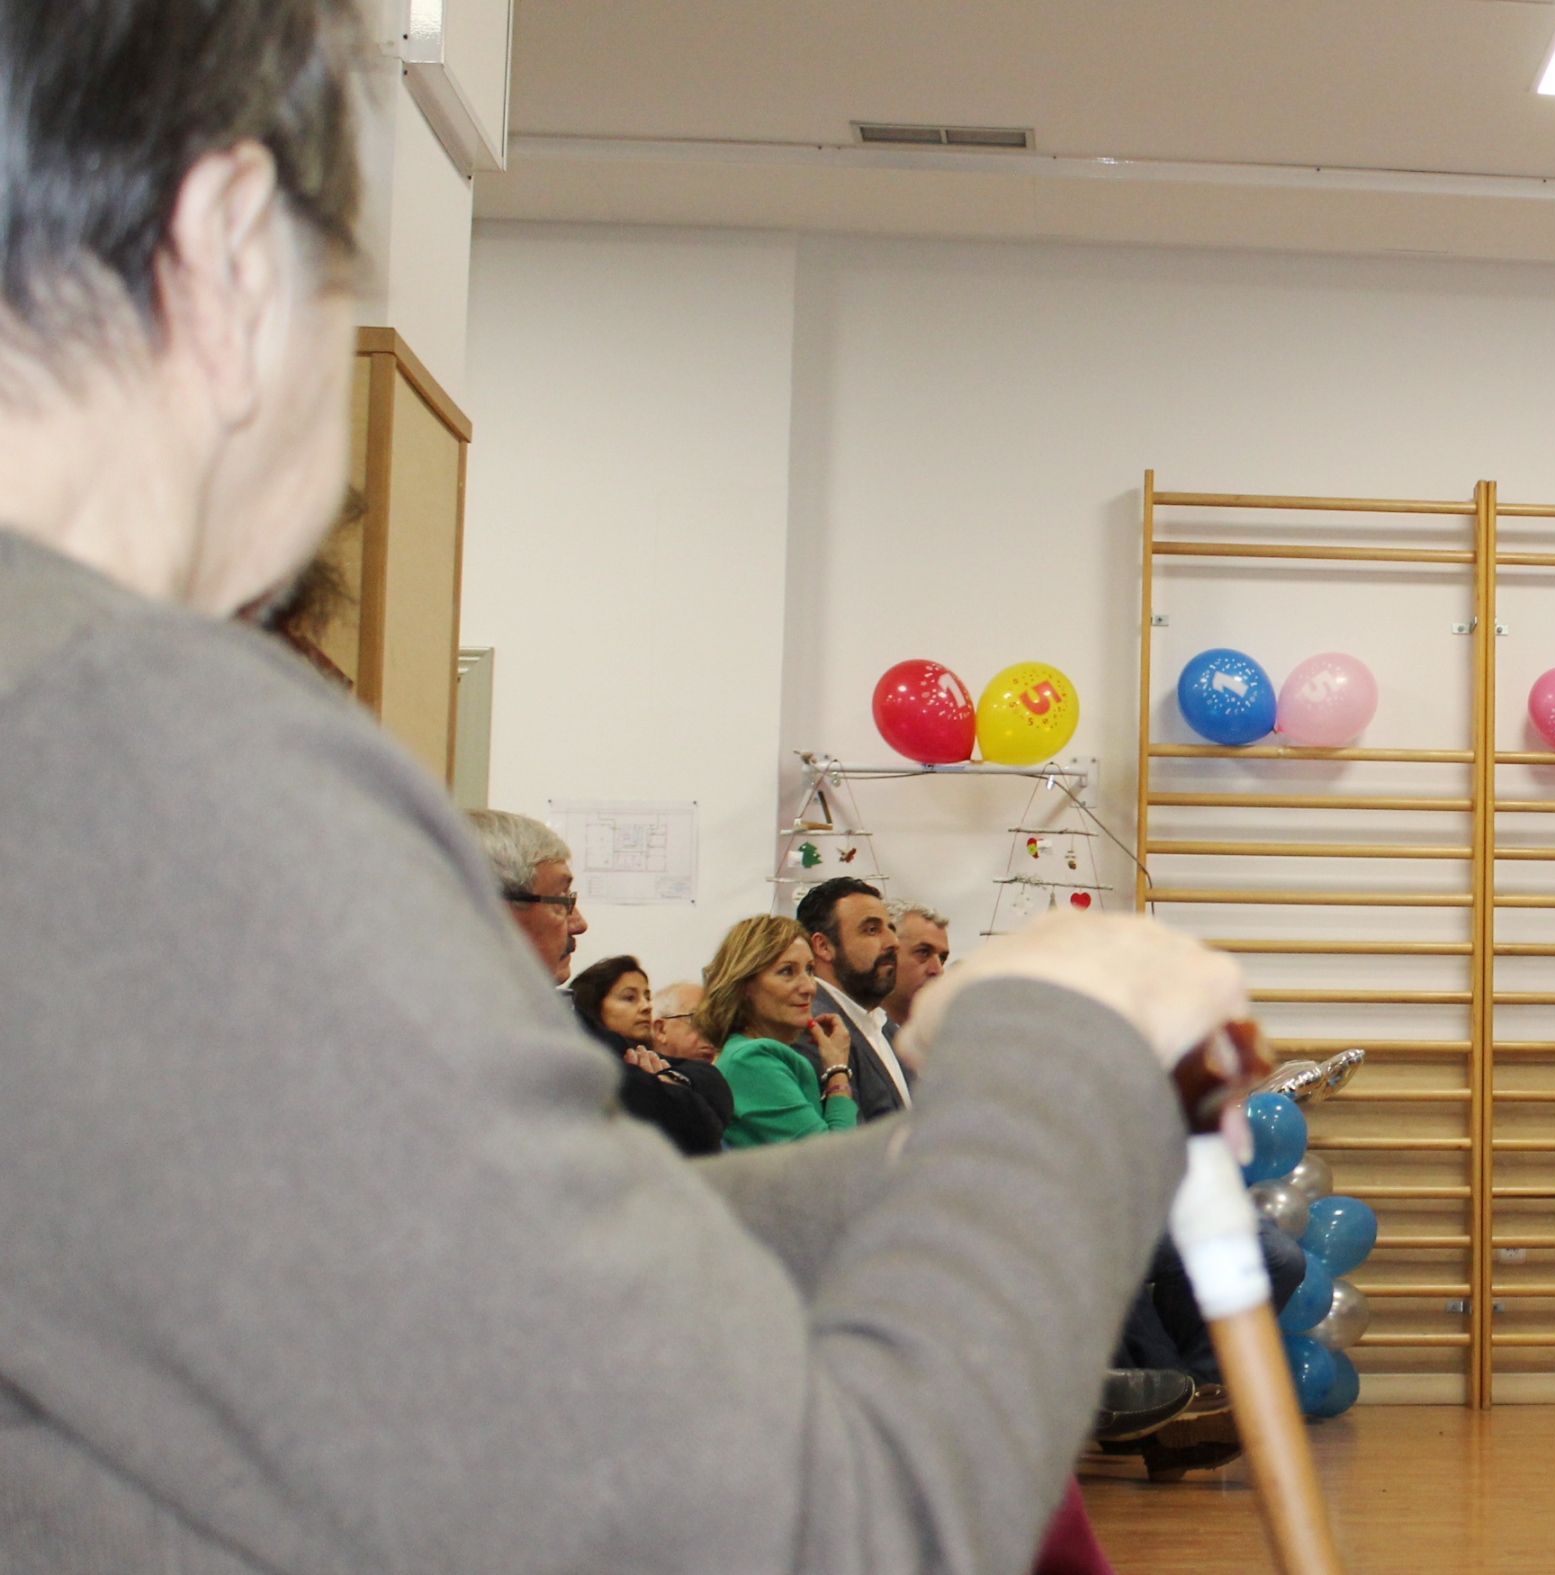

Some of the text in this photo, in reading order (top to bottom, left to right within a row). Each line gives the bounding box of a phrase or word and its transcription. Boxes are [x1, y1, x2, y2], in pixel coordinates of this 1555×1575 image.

[937, 672, 967, 708] 1
[1019, 679, 1062, 716] 5
[1212, 670, 1249, 698] 1
[1300, 670, 1342, 703] 5
